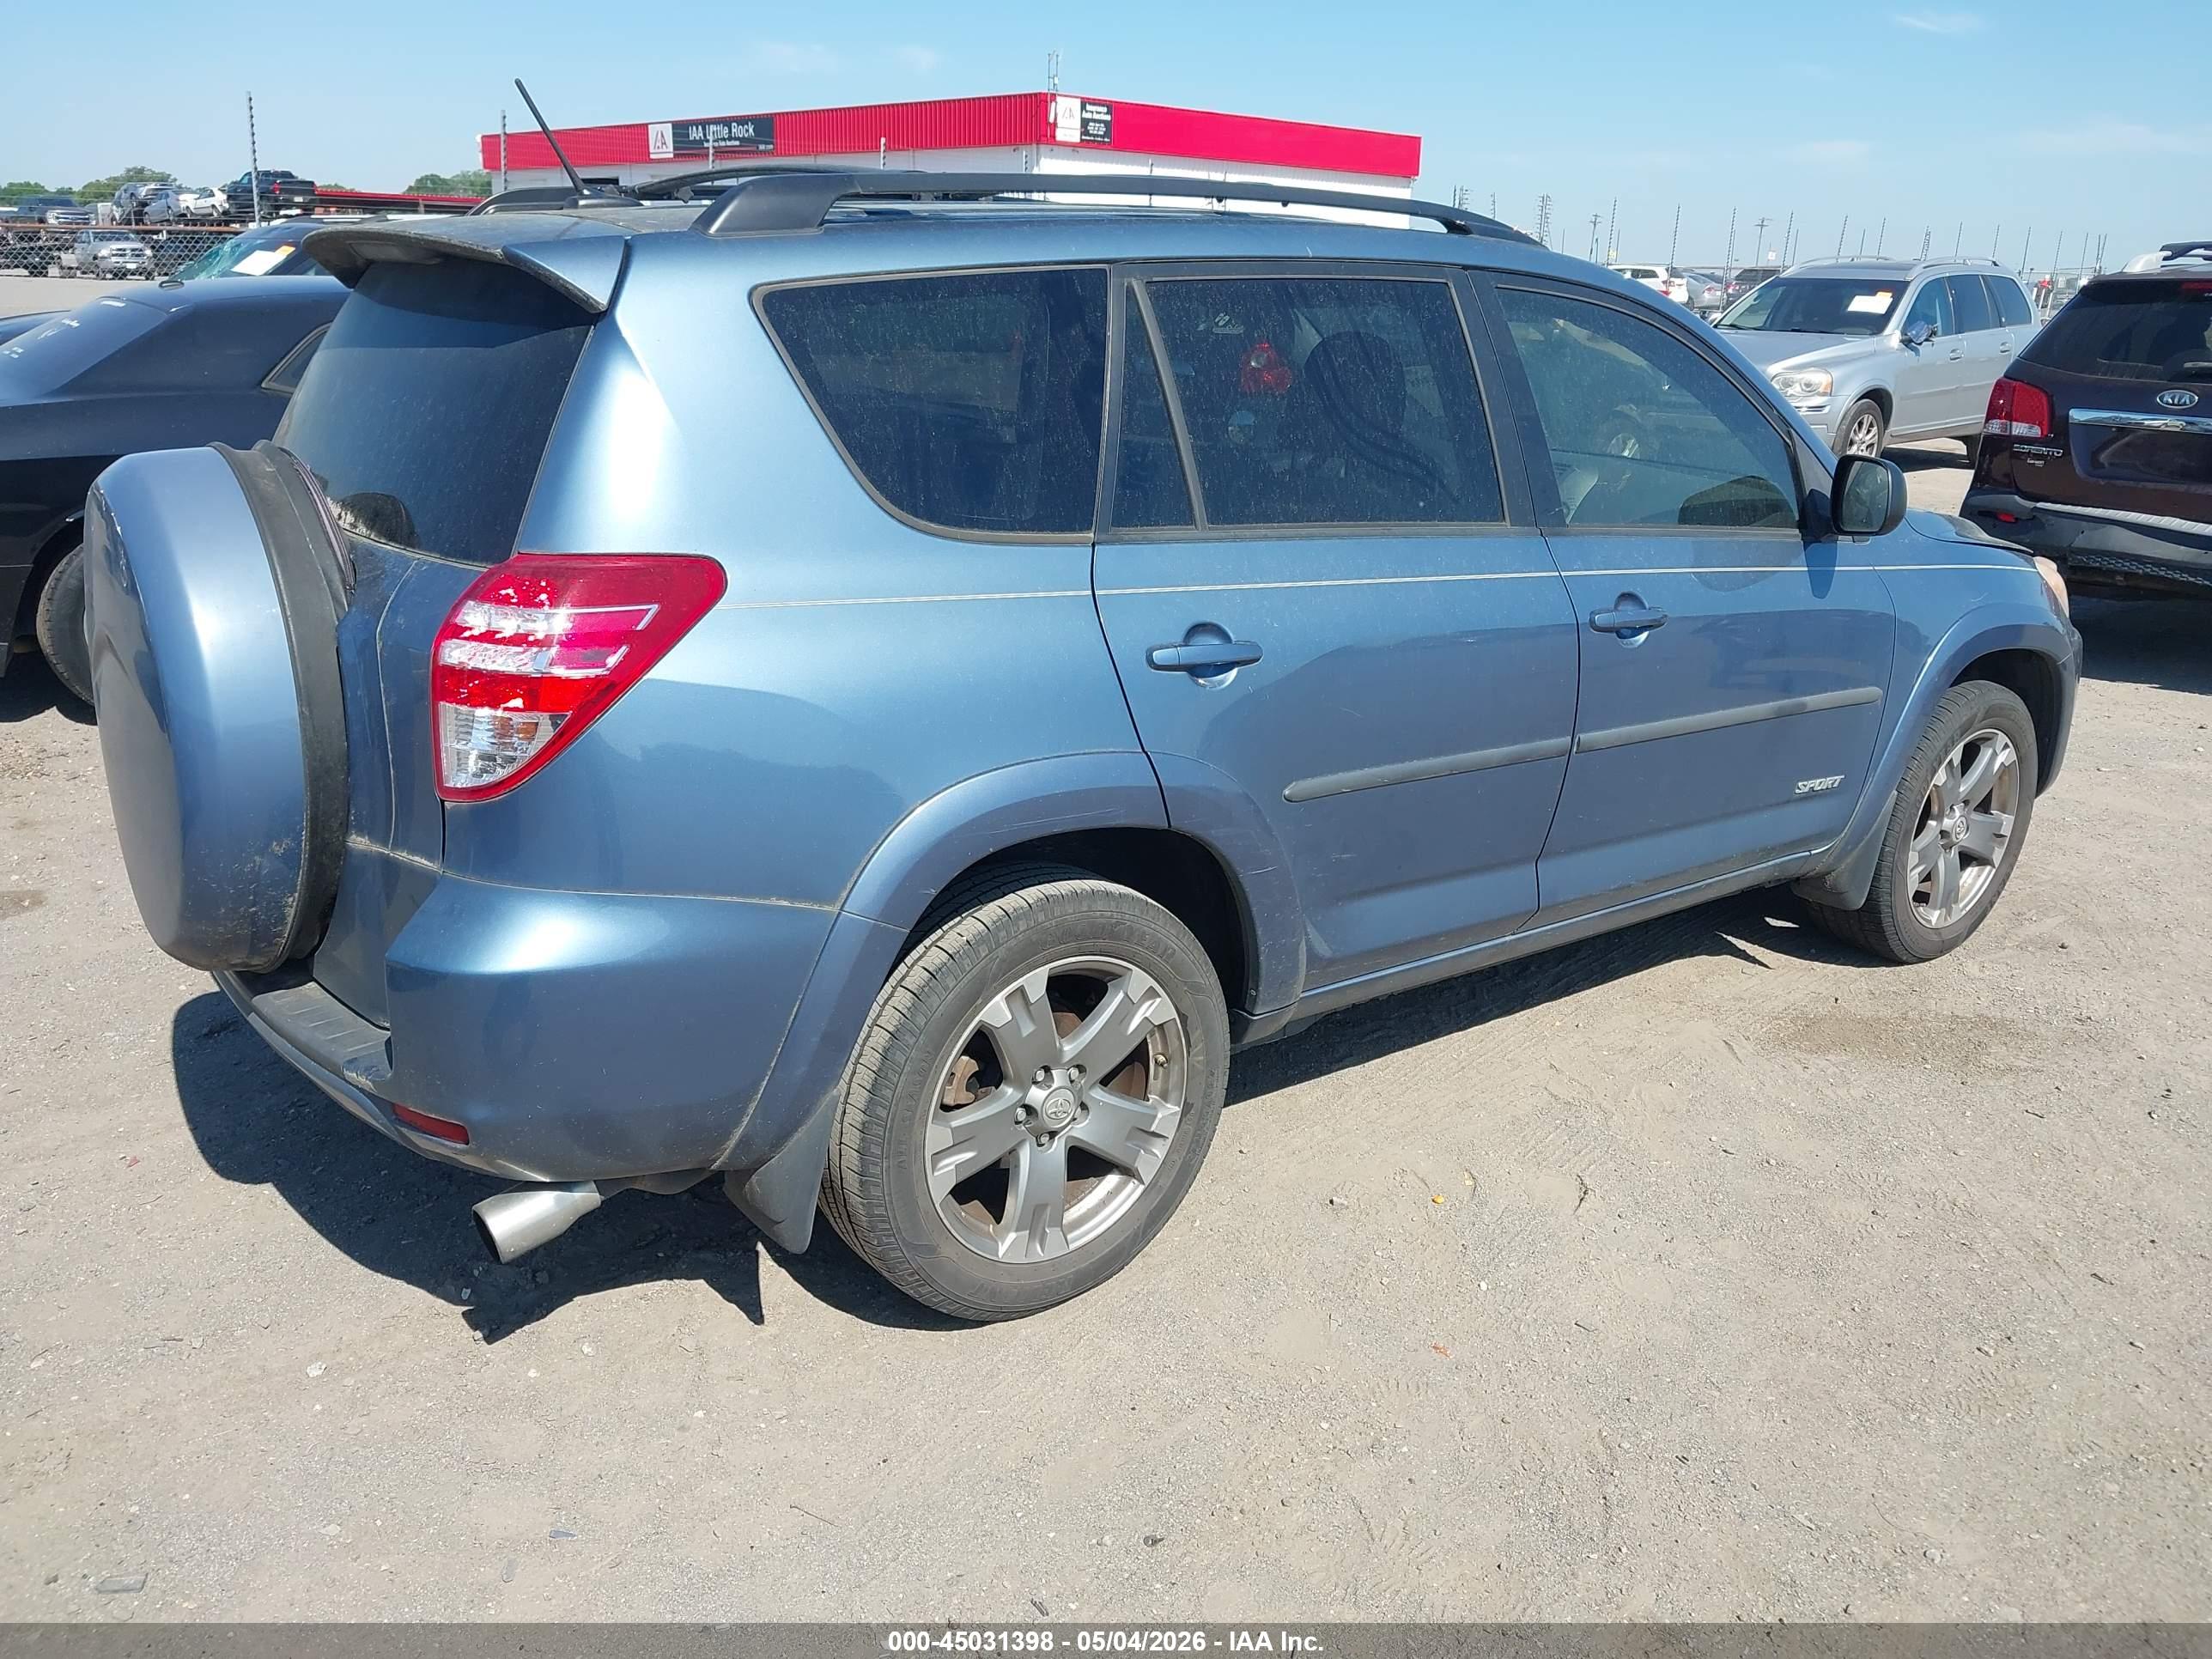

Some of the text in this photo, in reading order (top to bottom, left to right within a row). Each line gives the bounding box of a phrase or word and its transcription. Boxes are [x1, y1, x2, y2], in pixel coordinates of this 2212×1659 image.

[689, 125, 704, 140] IAA
[731, 121, 755, 138] Rock
[2163, 393, 2191, 404] KIA
[1795, 775, 1845, 794] SPORT
